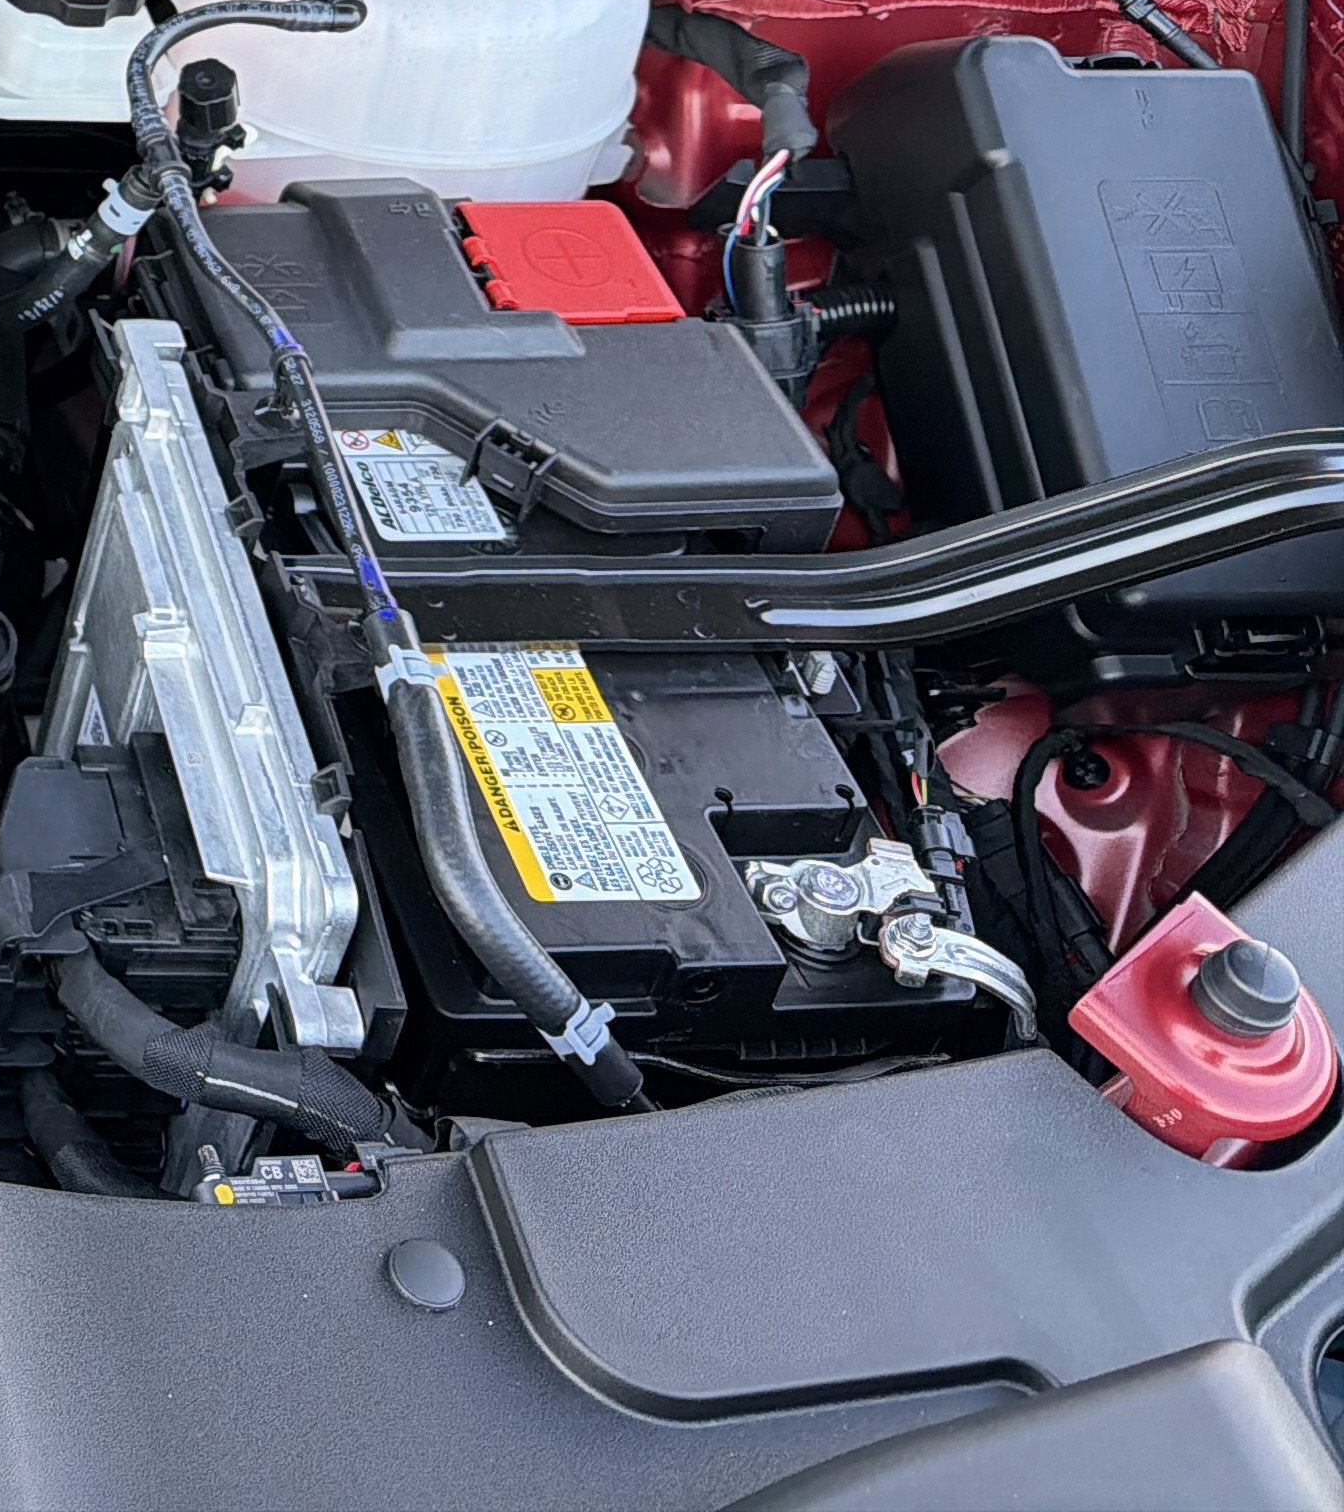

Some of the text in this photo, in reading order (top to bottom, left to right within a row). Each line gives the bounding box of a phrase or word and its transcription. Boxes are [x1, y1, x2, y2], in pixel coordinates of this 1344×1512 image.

[349, 461, 400, 530] ACDelco
[445, 695, 514, 818] DANGER/POISON
[260, 1165, 284, 1180] CB
